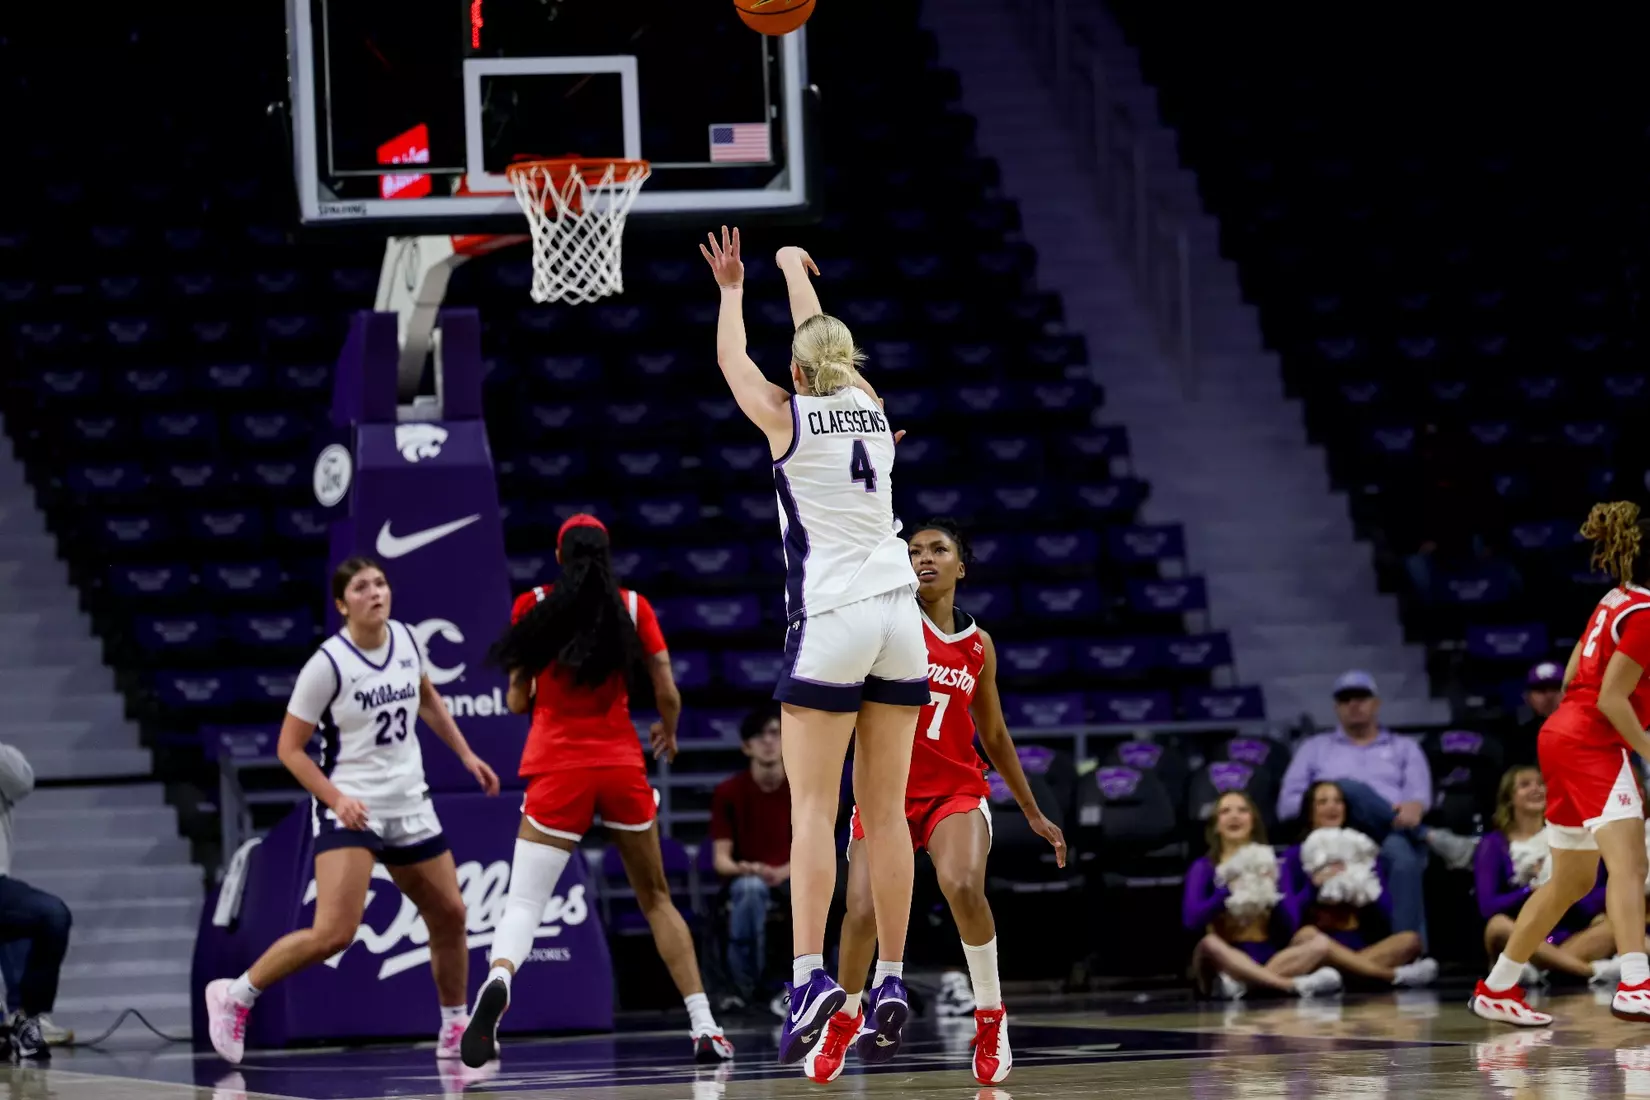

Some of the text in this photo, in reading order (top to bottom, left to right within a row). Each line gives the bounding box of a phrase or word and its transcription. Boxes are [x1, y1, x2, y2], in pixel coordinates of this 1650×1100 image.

[808, 410, 886, 435] CLAESSENS
[850, 439, 877, 493] 4
[1583, 608, 1608, 658] 2
[354, 682, 416, 711] Wildcats
[928, 662, 976, 696] ouston
[375, 707, 408, 745] 23
[926, 691, 951, 741] 7
